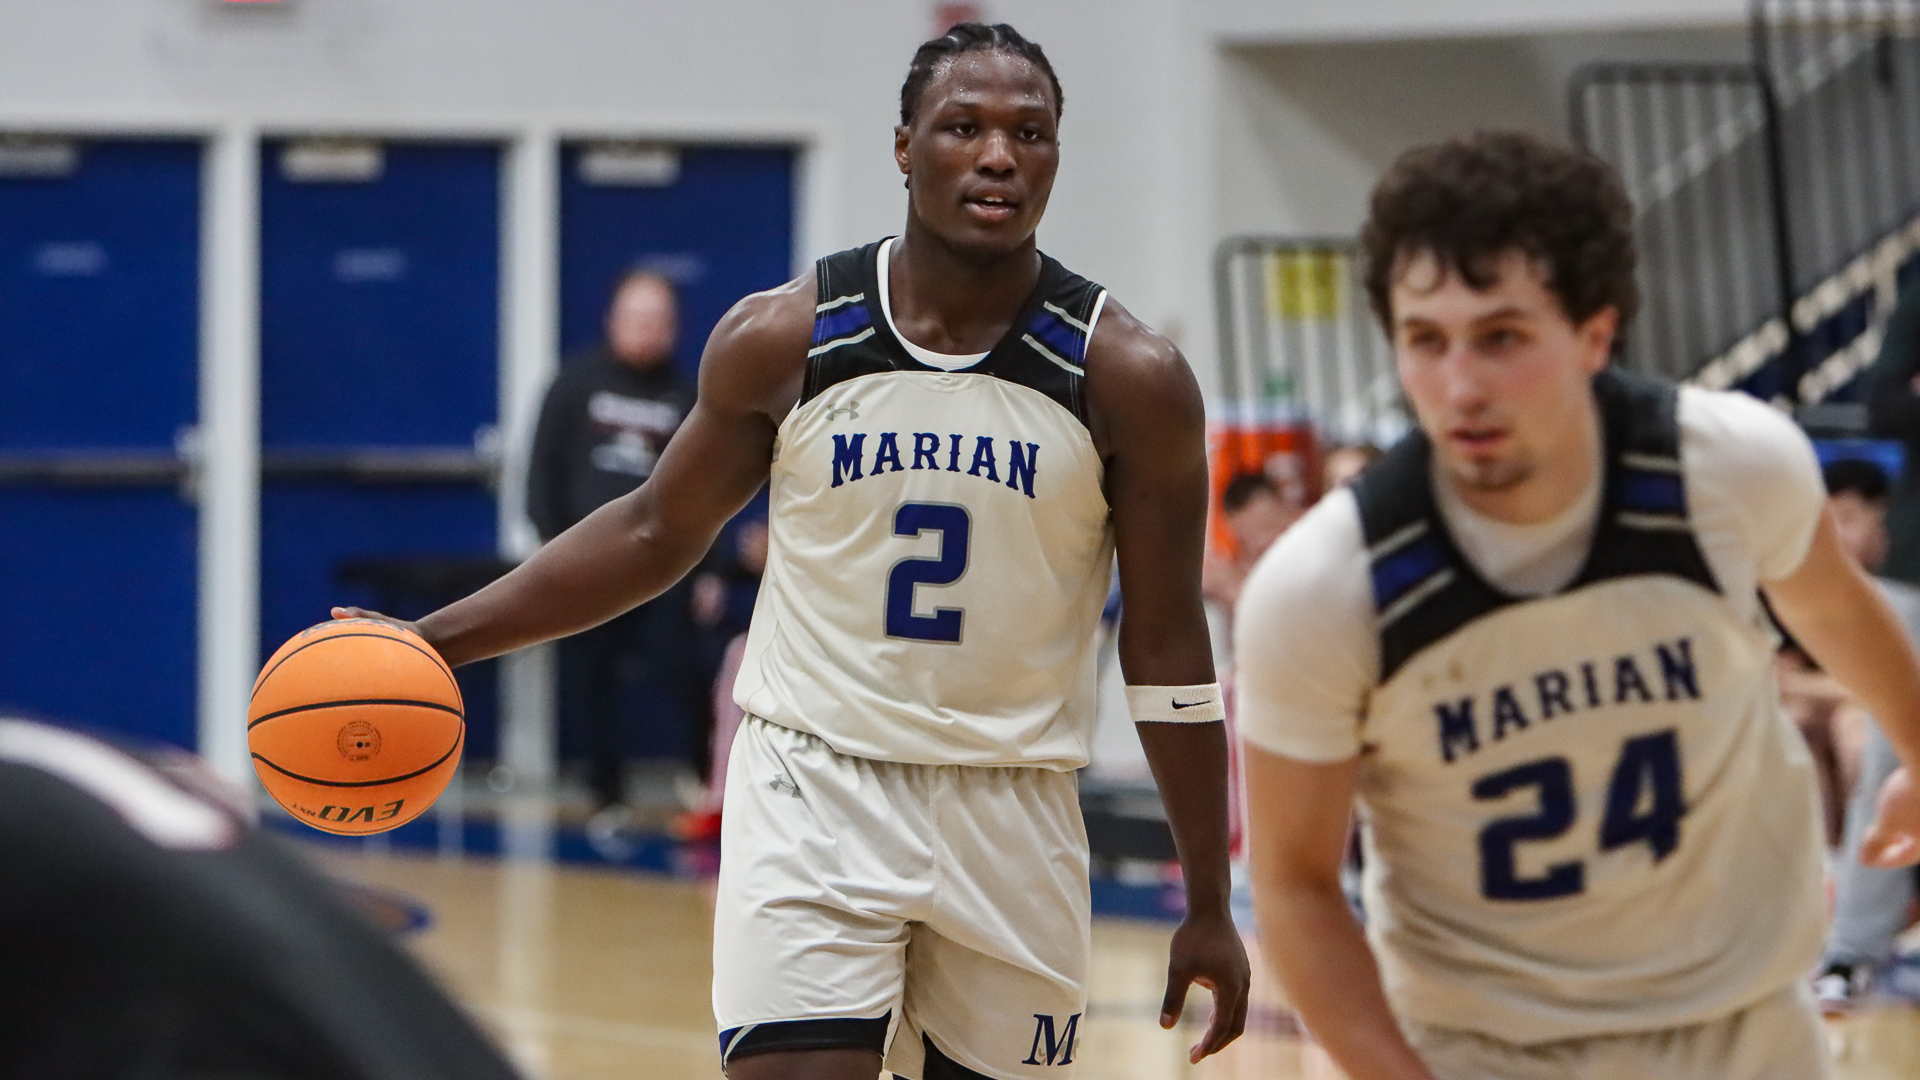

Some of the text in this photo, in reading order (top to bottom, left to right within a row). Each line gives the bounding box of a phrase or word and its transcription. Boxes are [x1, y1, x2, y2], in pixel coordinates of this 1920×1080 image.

[831, 432, 1040, 498] MARIAN
[883, 500, 973, 645] 2
[1432, 635, 1702, 763] MARIAN
[317, 798, 405, 824] EVO
[1471, 728, 1686, 901] 24
[1021, 1012, 1082, 1066] M
